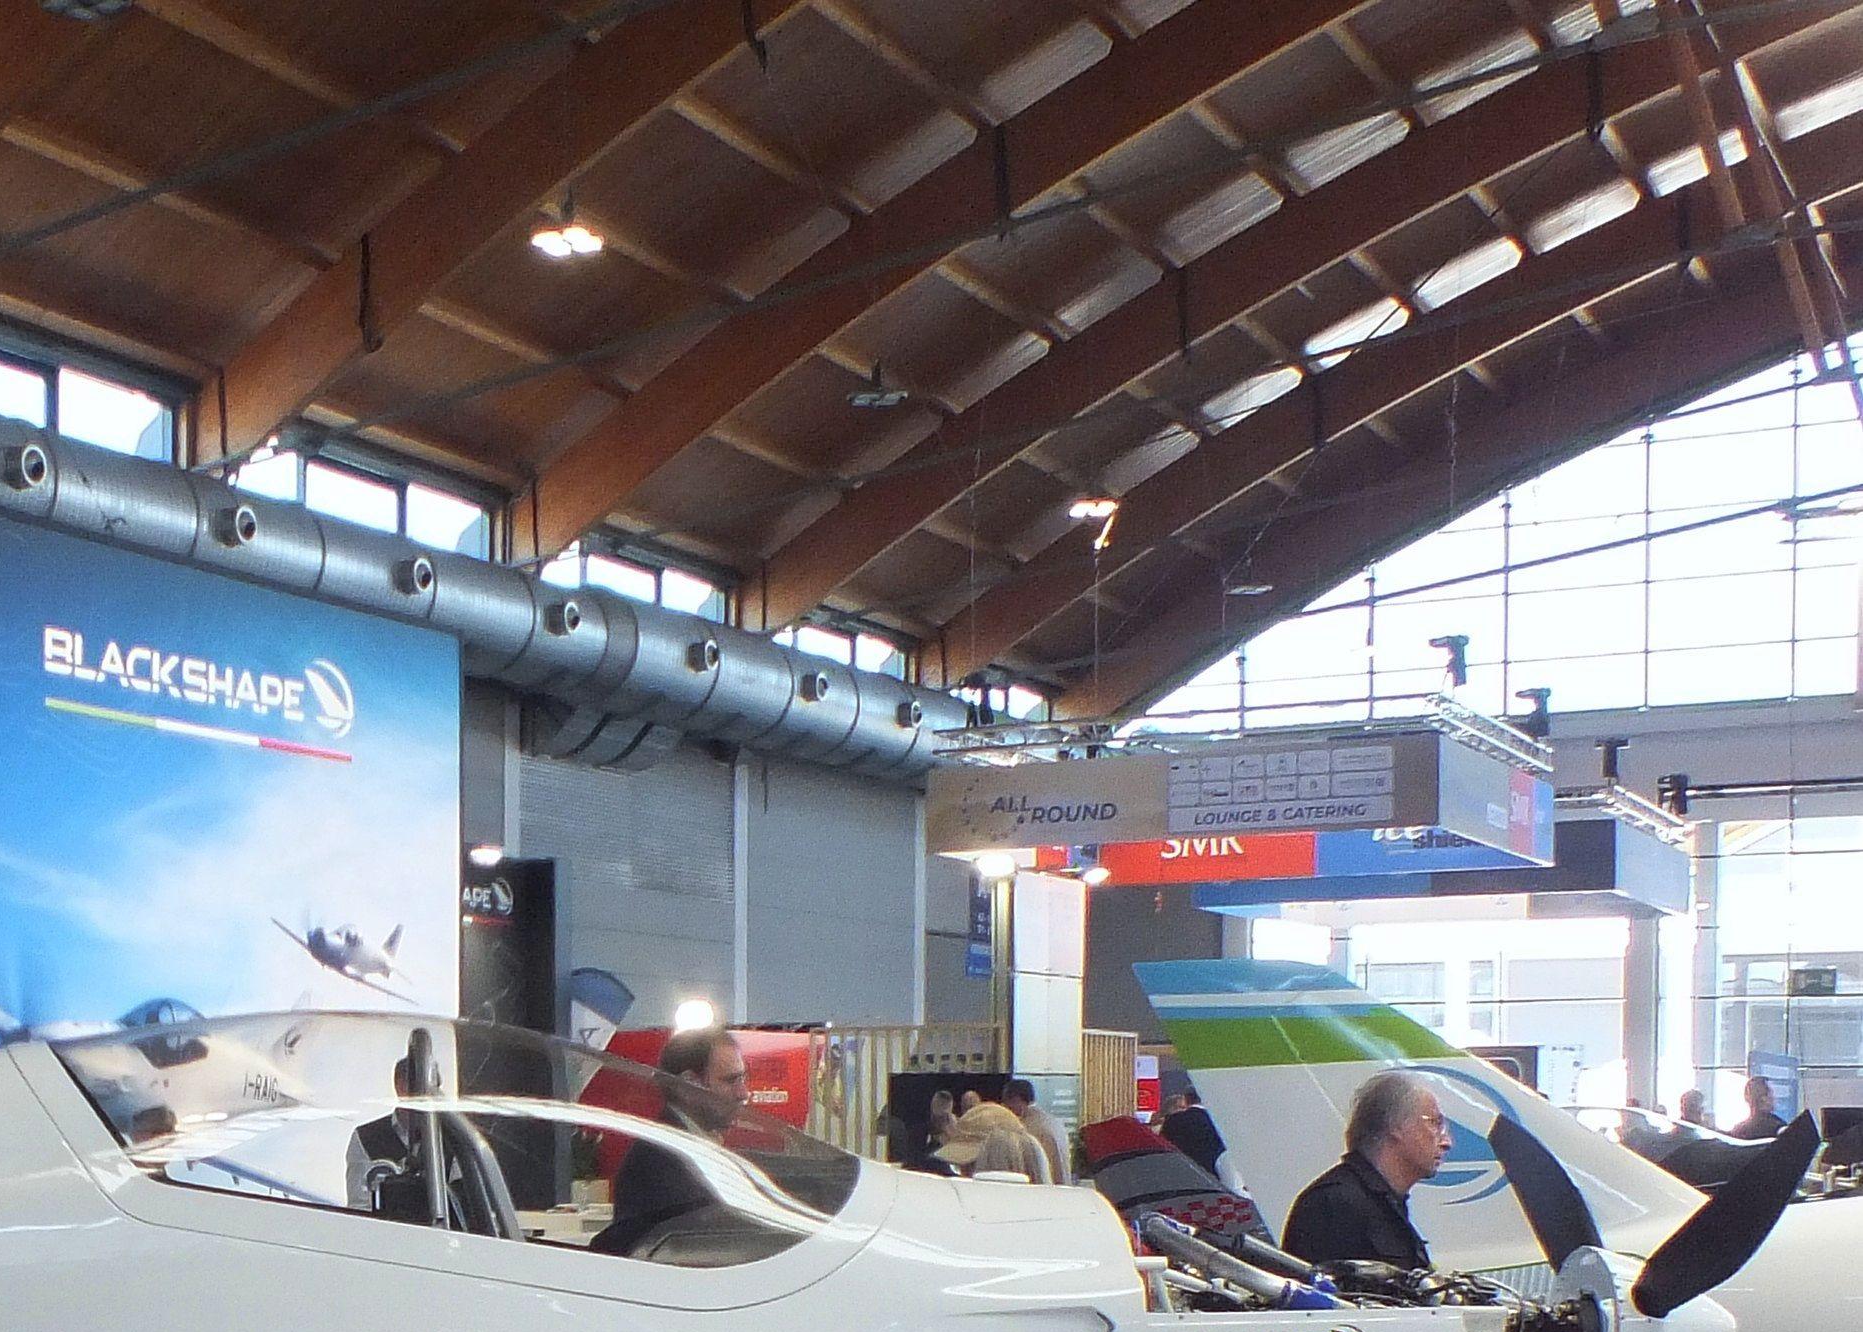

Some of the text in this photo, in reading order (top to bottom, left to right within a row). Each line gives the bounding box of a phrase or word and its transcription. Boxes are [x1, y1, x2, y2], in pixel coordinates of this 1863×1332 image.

[43, 627, 305, 721] BLACKSHAPE
[991, 796, 1031, 813] ALL
[1031, 802, 1118, 824] ROUND
[1195, 808, 1262, 826] LOUNGE
[1282, 803, 1366, 821] CATERING
